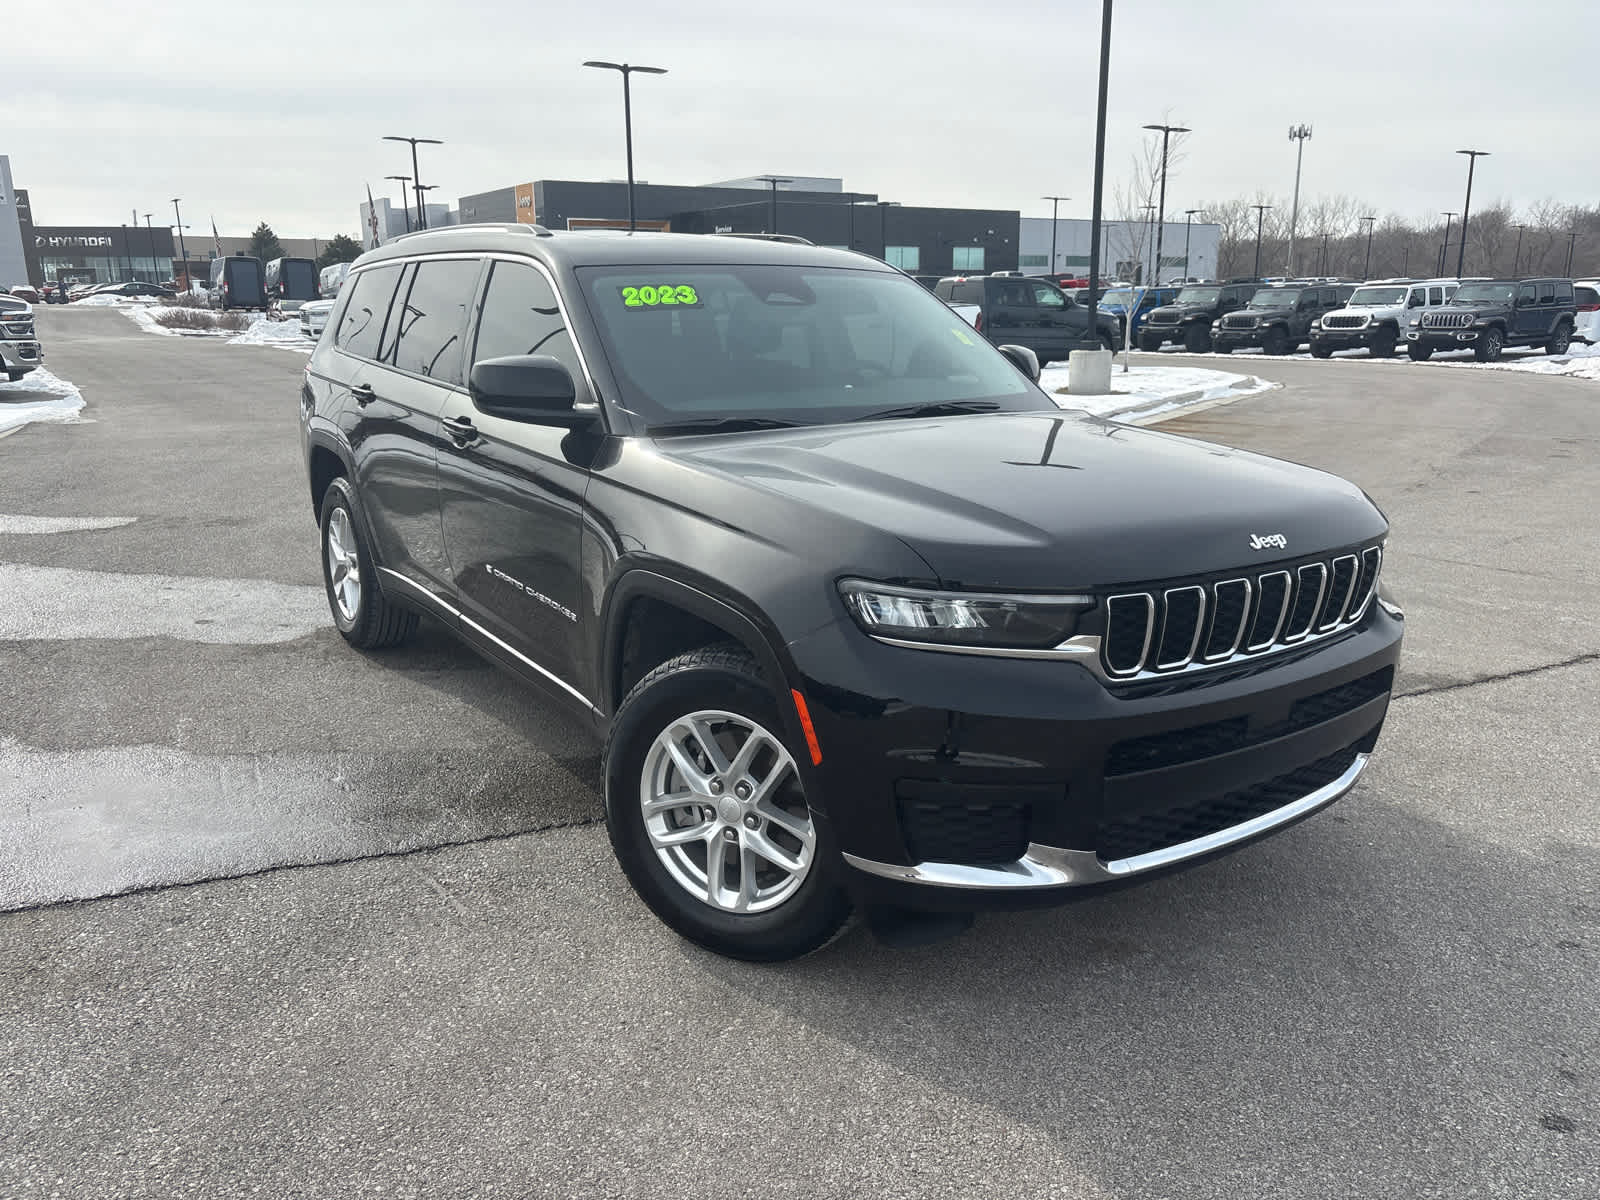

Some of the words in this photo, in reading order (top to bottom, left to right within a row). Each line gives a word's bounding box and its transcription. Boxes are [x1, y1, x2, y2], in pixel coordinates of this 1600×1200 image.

[49, 236, 112, 247] HYUNDAI
[622, 285, 698, 306] 2023
[1249, 534, 1287, 549] Jeep
[525, 586, 577, 622] CHEROKEE
